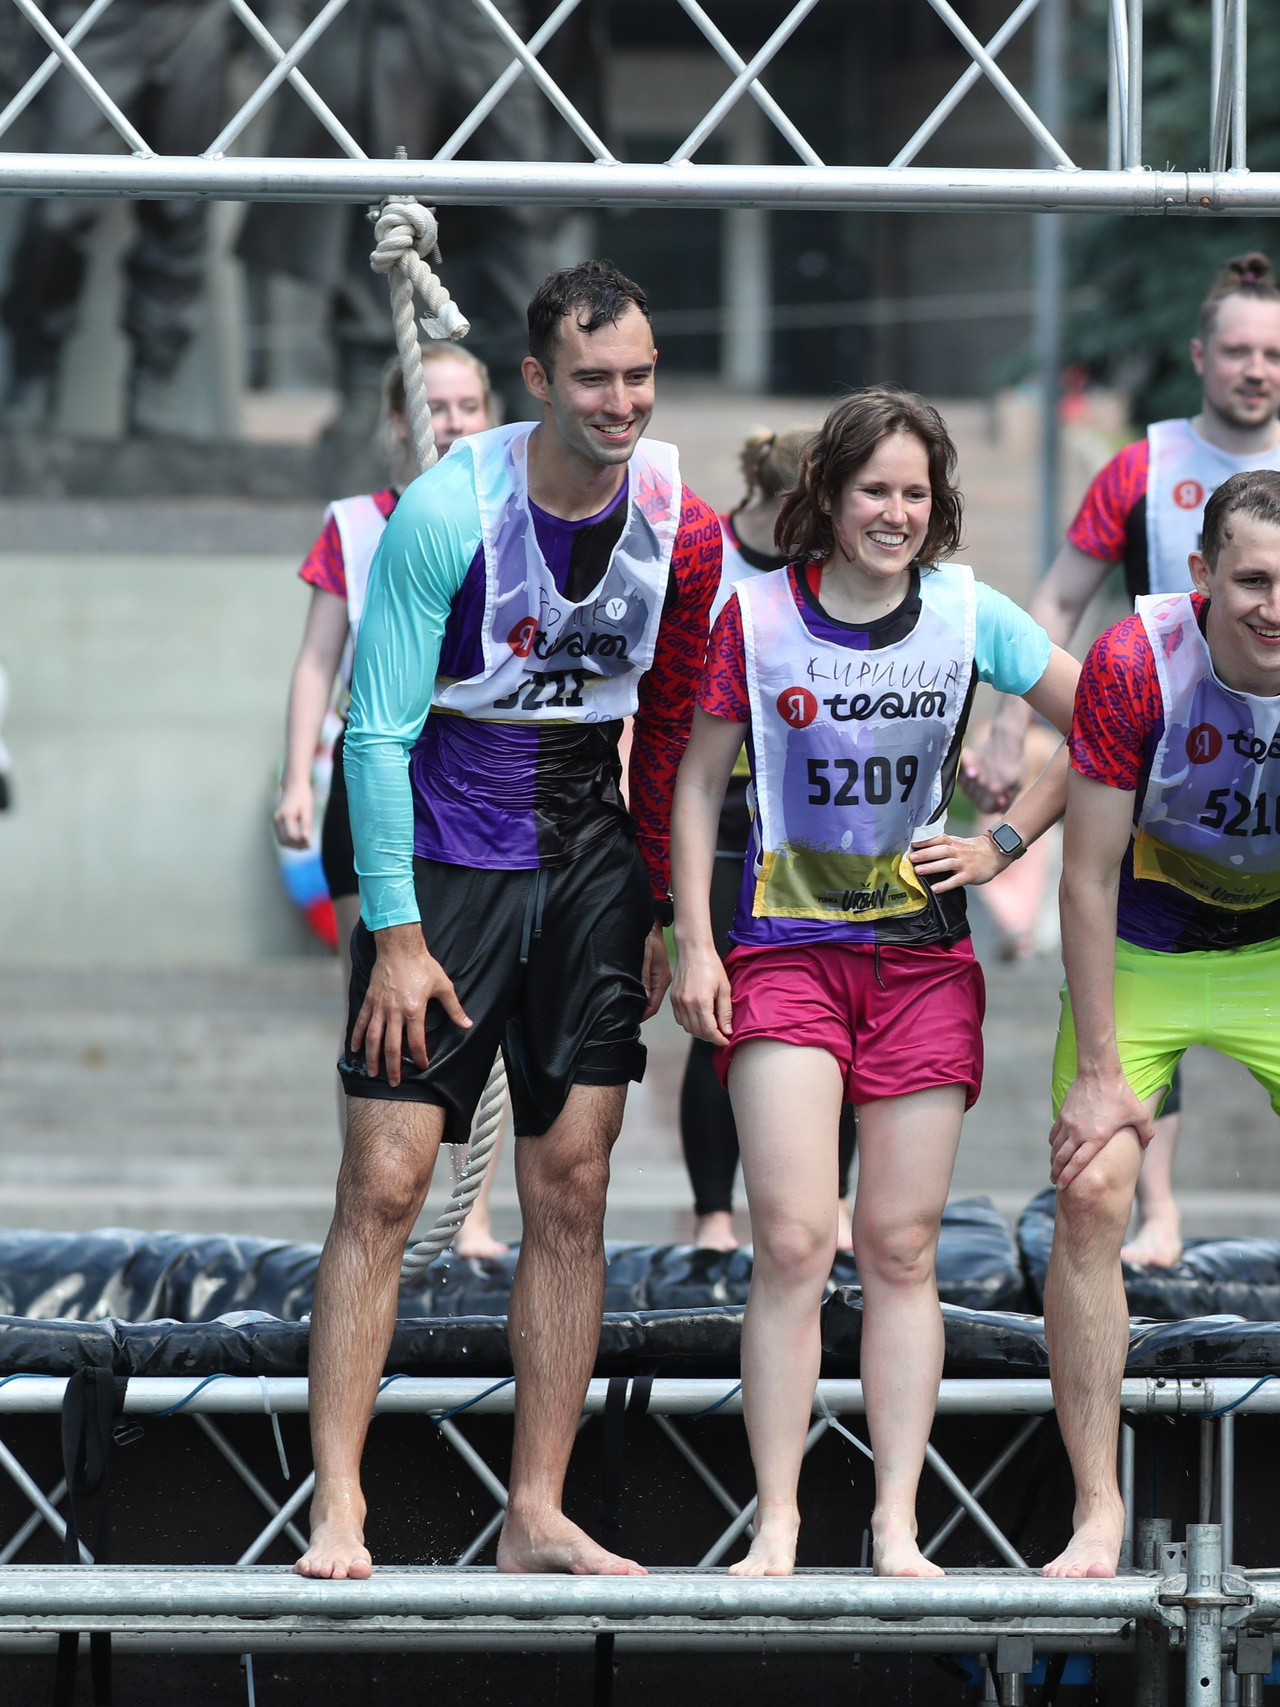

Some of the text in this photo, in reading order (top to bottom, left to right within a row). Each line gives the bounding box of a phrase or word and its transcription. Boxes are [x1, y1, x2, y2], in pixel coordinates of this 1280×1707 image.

[519, 625, 534, 651] Я
[787, 690, 947, 722] Я team
[1195, 731, 1210, 758] Я
[807, 754, 918, 806] 5209
[841, 882, 889, 914] URBAN
